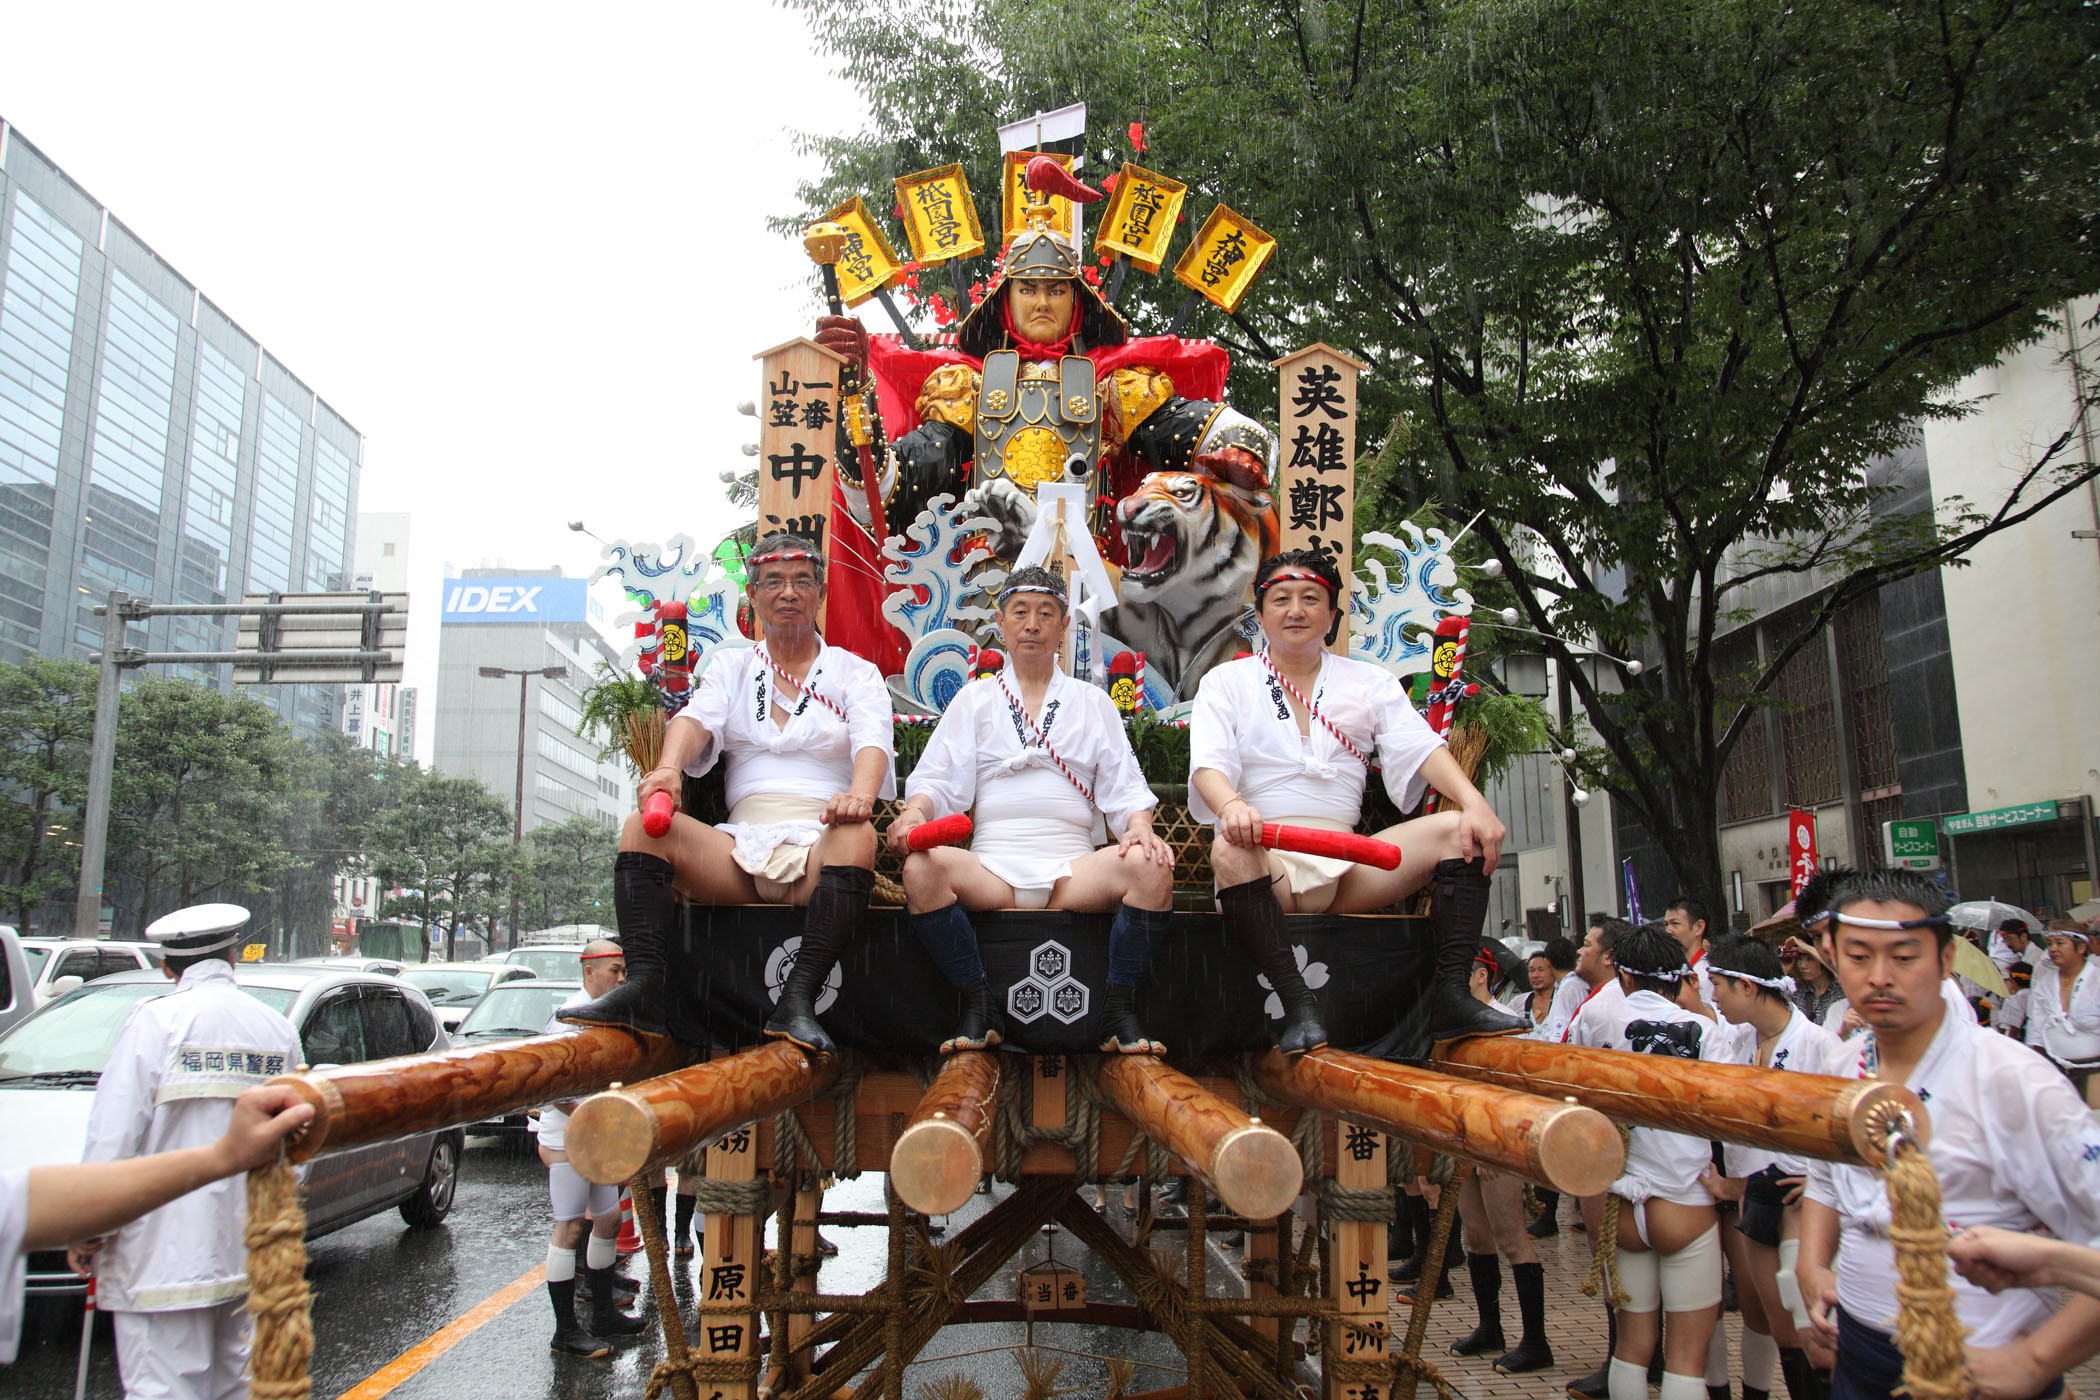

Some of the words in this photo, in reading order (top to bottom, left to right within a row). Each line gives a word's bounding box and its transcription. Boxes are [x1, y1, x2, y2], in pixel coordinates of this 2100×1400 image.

[840, 226, 873, 282] 神宮
[1201, 230, 1246, 288] 大神宮
[1289, 365, 1348, 647] 英雄鄭成
[446, 586, 543, 613] IDEX
[1975, 806, 2052, 828] 自動サービスコーナー
[1898, 827, 1918, 838] 自動
[1894, 840, 1936, 853] サービスコーナー
[182, 1051, 284, 1075] 福岡県警察
[1345, 1124, 1381, 1161] 番
[1037, 1281, 1079, 1303] 当番
[706, 1263, 748, 1400] 原田
